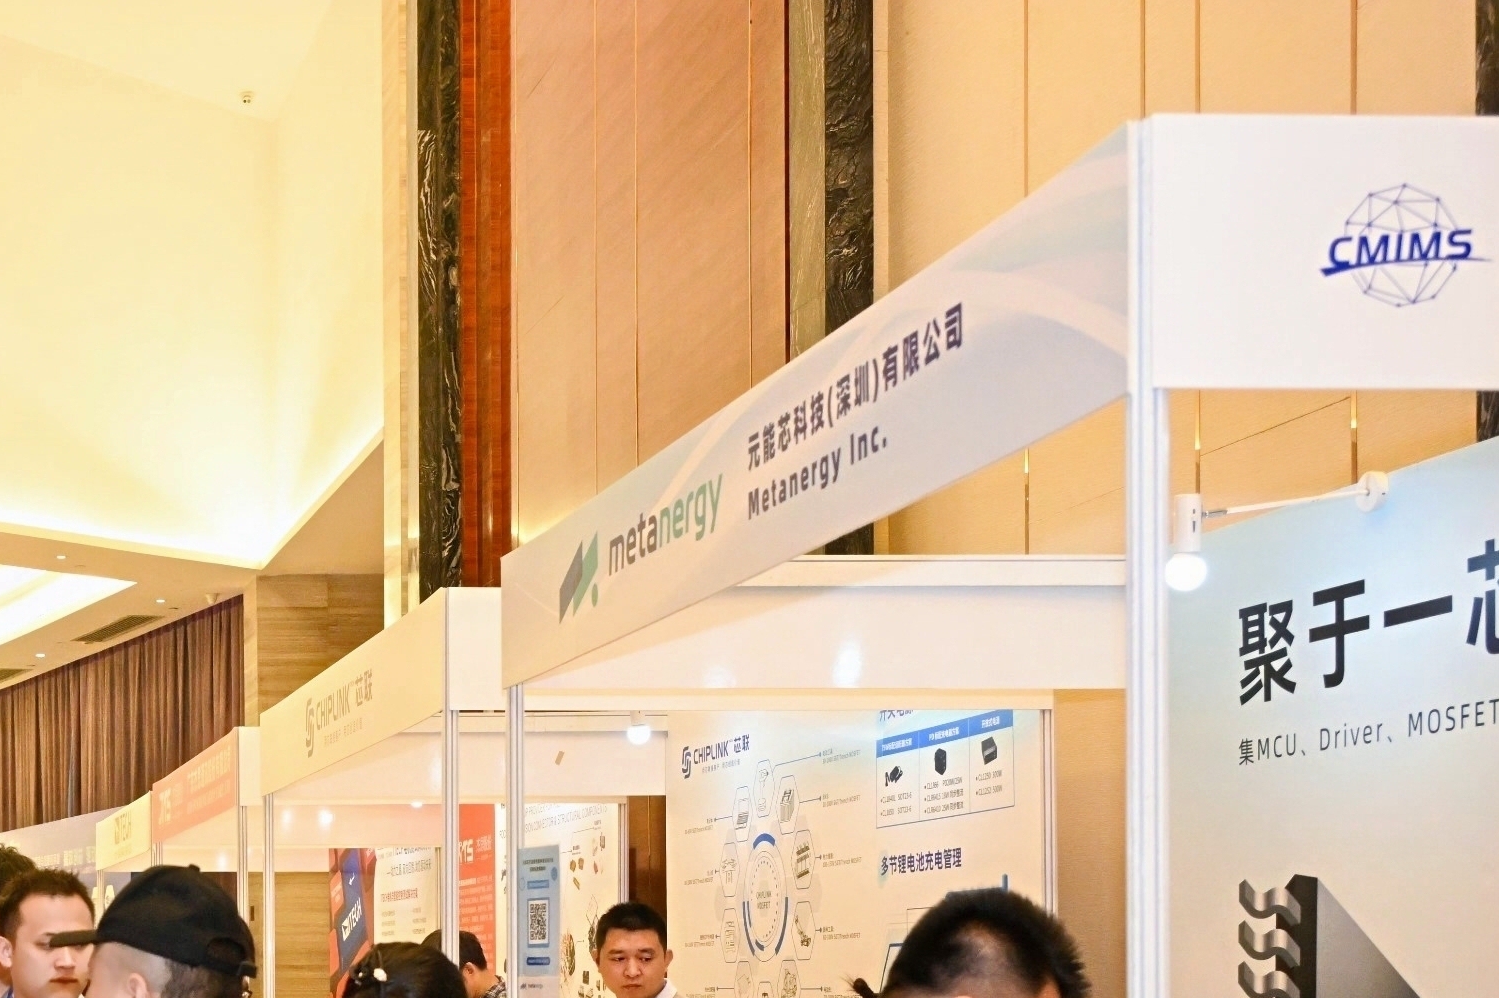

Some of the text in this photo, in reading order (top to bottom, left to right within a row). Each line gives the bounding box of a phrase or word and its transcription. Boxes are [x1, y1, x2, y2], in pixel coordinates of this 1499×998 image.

[1327, 229, 1473, 270] CMIMS
[748, 302, 963, 471] 元能芯科技(深圳)有限公司
[748, 426, 887, 520] Metanergy Inc.
[608, 473, 723, 578] metanergy
[316, 668, 373, 730] CHIPLINK 芯联
[693, 734, 750, 764] CHIPLINK 芯联
[881, 847, 962, 876] 多节锂电池充电管理
